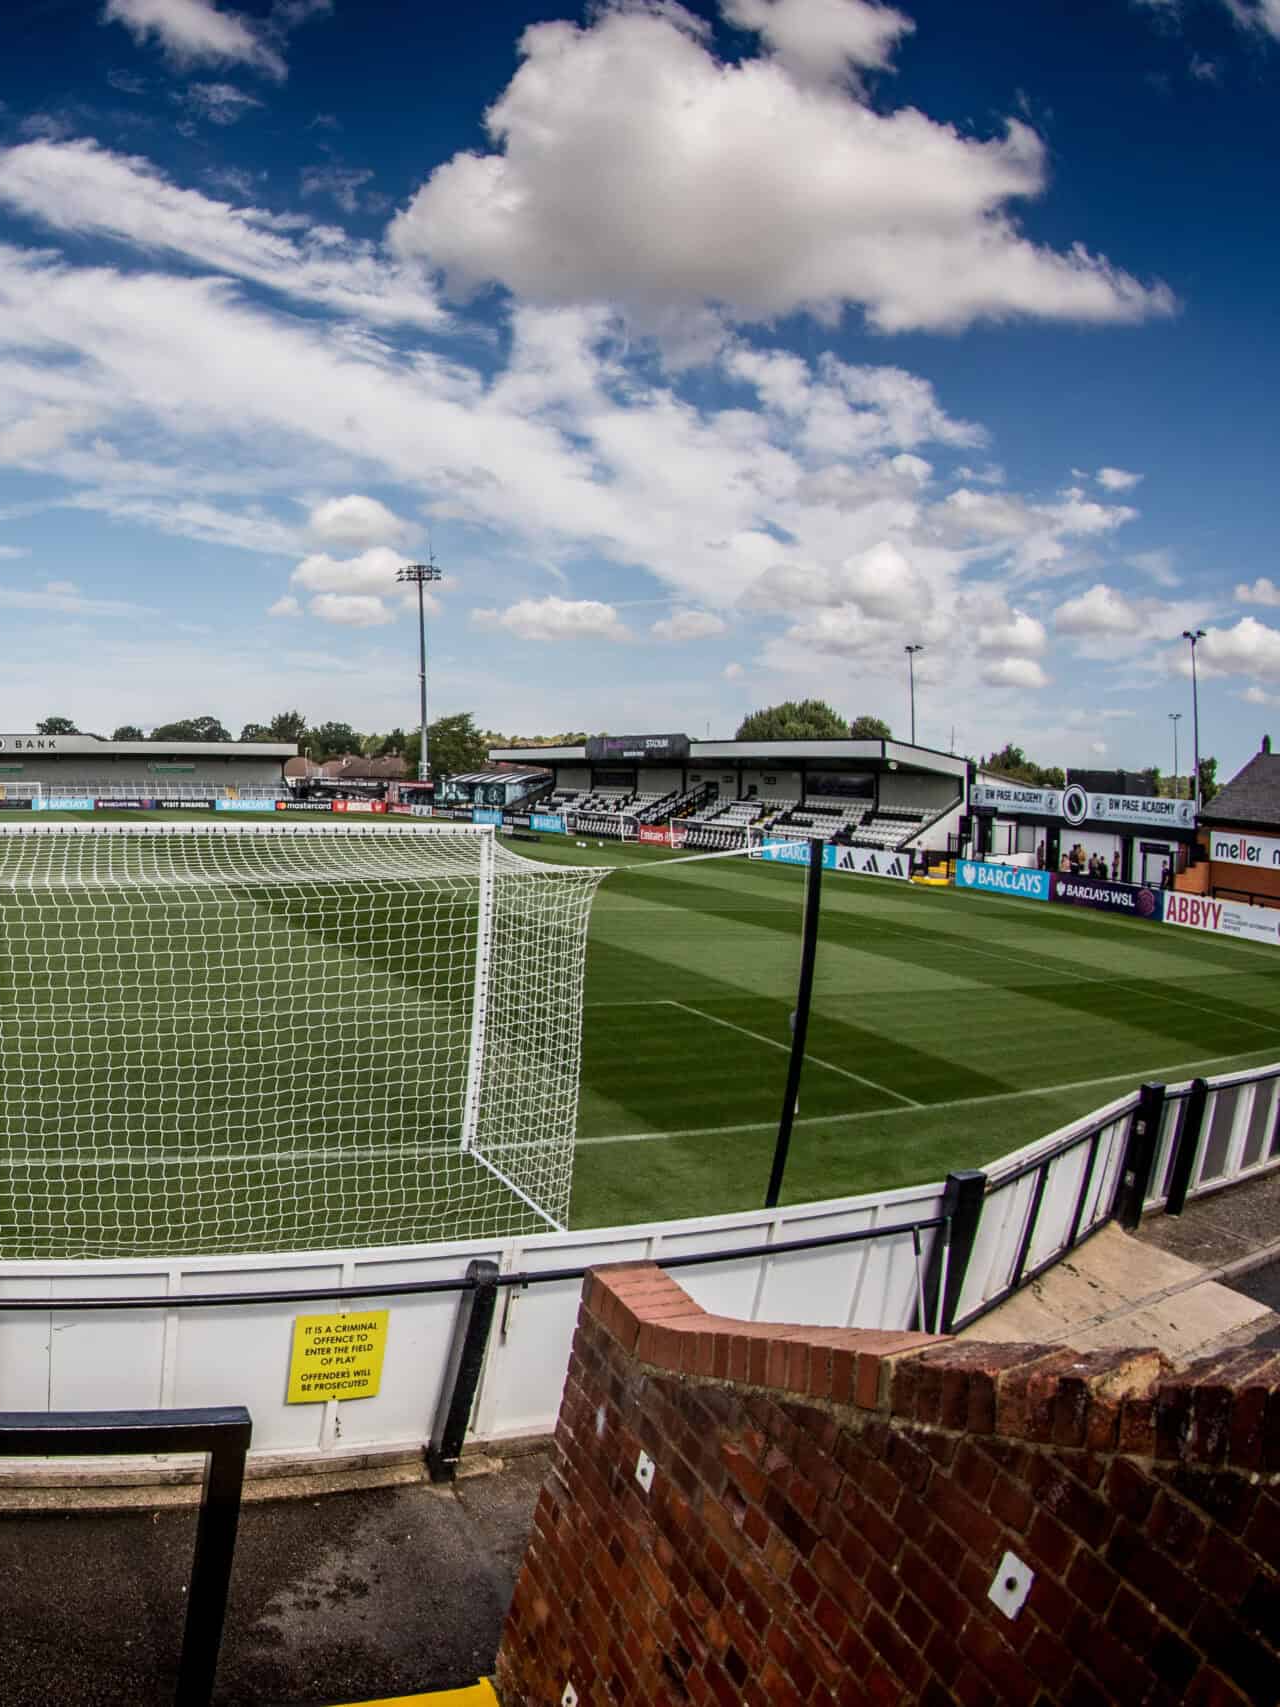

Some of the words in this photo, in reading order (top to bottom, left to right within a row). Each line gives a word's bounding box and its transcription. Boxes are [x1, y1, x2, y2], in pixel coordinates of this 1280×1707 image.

[16, 740, 56, 749] BANK
[1013, 791, 1042, 803] ACADEMY
[287, 801, 332, 810] mastercard
[1122, 800, 1139, 811] PASE
[1142, 801, 1176, 815] ACADEMY
[1215, 840, 1261, 862] meller
[978, 867, 1042, 893] BARCLAYS
[1066, 884, 1109, 903] BARCLAYS
[1110, 891, 1135, 907] WSL
[1166, 896, 1222, 930] ABBYY
[305, 1327, 312, 1335] IT
[315, 1326, 322, 1334] IS
[325, 1325, 332, 1333] A
[334, 1322, 377, 1333] CRIMINAL
[313, 1335, 353, 1345] OFFENCE
[357, 1334, 368, 1342] TO
[305, 1347, 331, 1356] ENTER
[334, 1345, 349, 1354] THE
[351, 1343, 373, 1353] FIELD
[320, 1358, 333, 1366] OF
[336, 1356, 356, 1365] PLAY
[301, 1371, 350, 1381] OFFENDERS
[353, 1368, 371, 1377] WILL
[301, 1383, 312, 1392] BE
[314, 1379, 368, 1391] PROSECUTED
